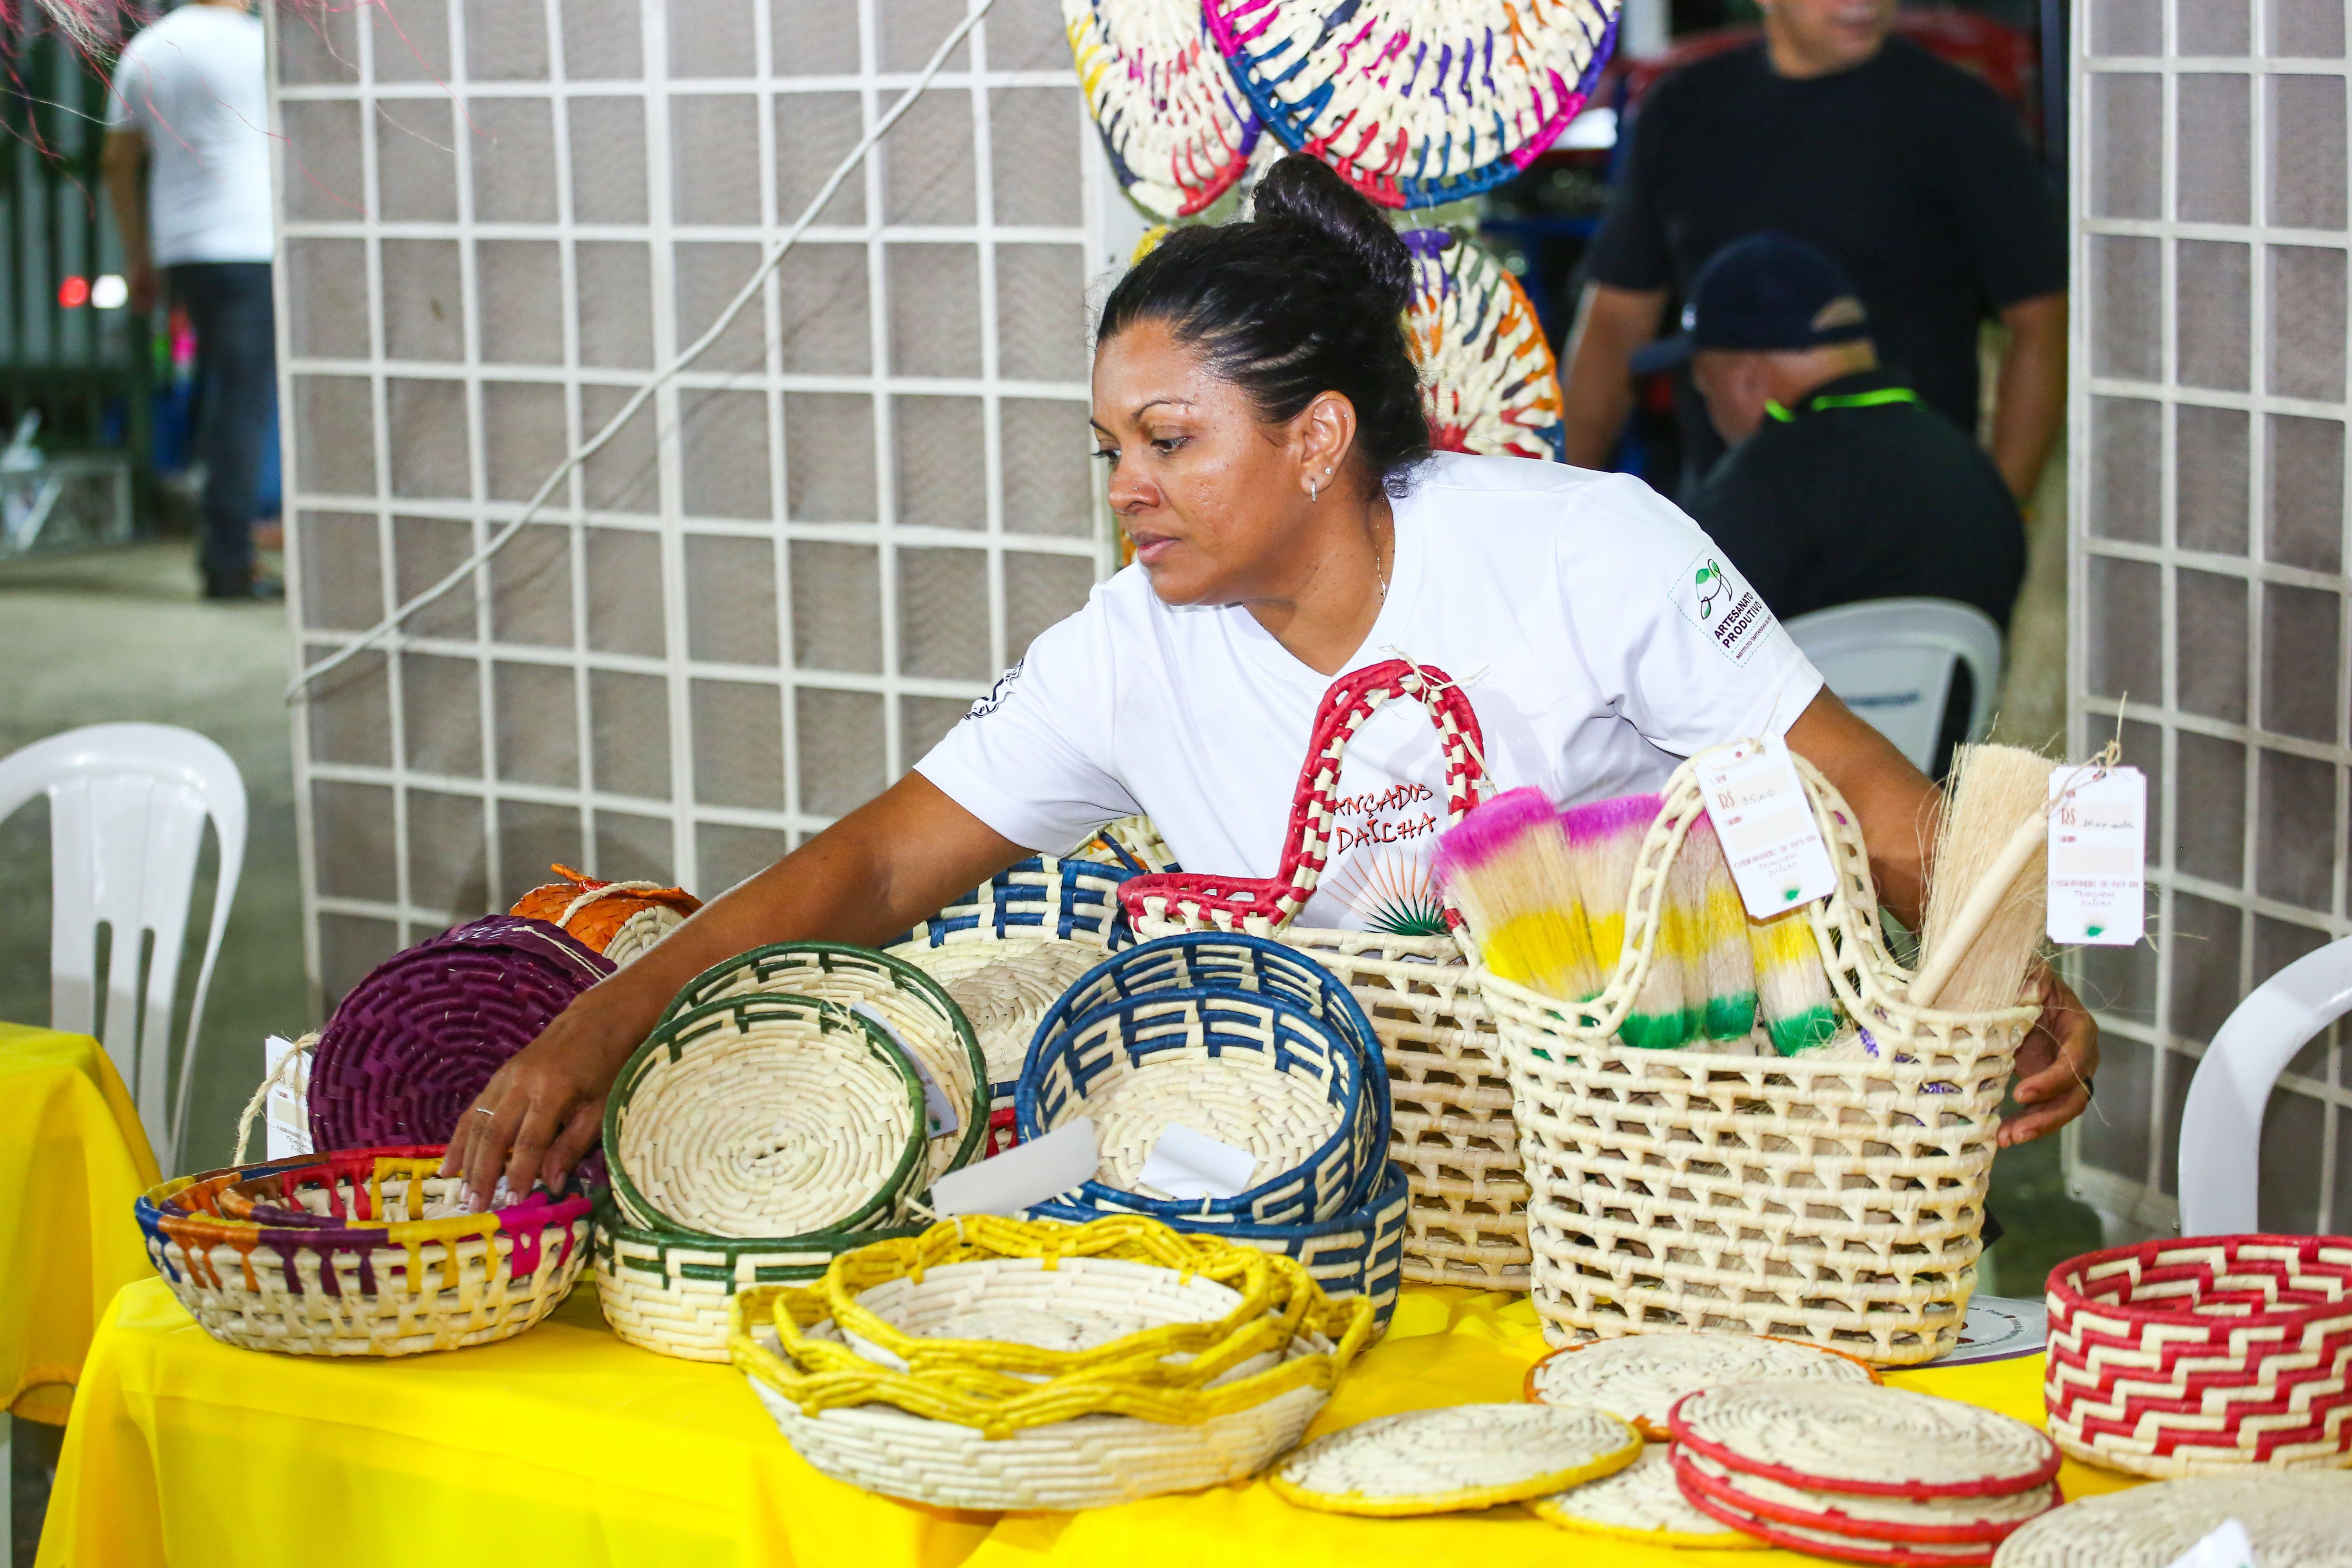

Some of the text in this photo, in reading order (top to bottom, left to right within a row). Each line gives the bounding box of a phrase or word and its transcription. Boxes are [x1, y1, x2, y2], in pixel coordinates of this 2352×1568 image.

[1714, 592, 1753, 640] ARTESANATO
[1722, 601, 1762, 648] PRODUTIVO
[1736, 640, 1753, 659] INSTITUTO
